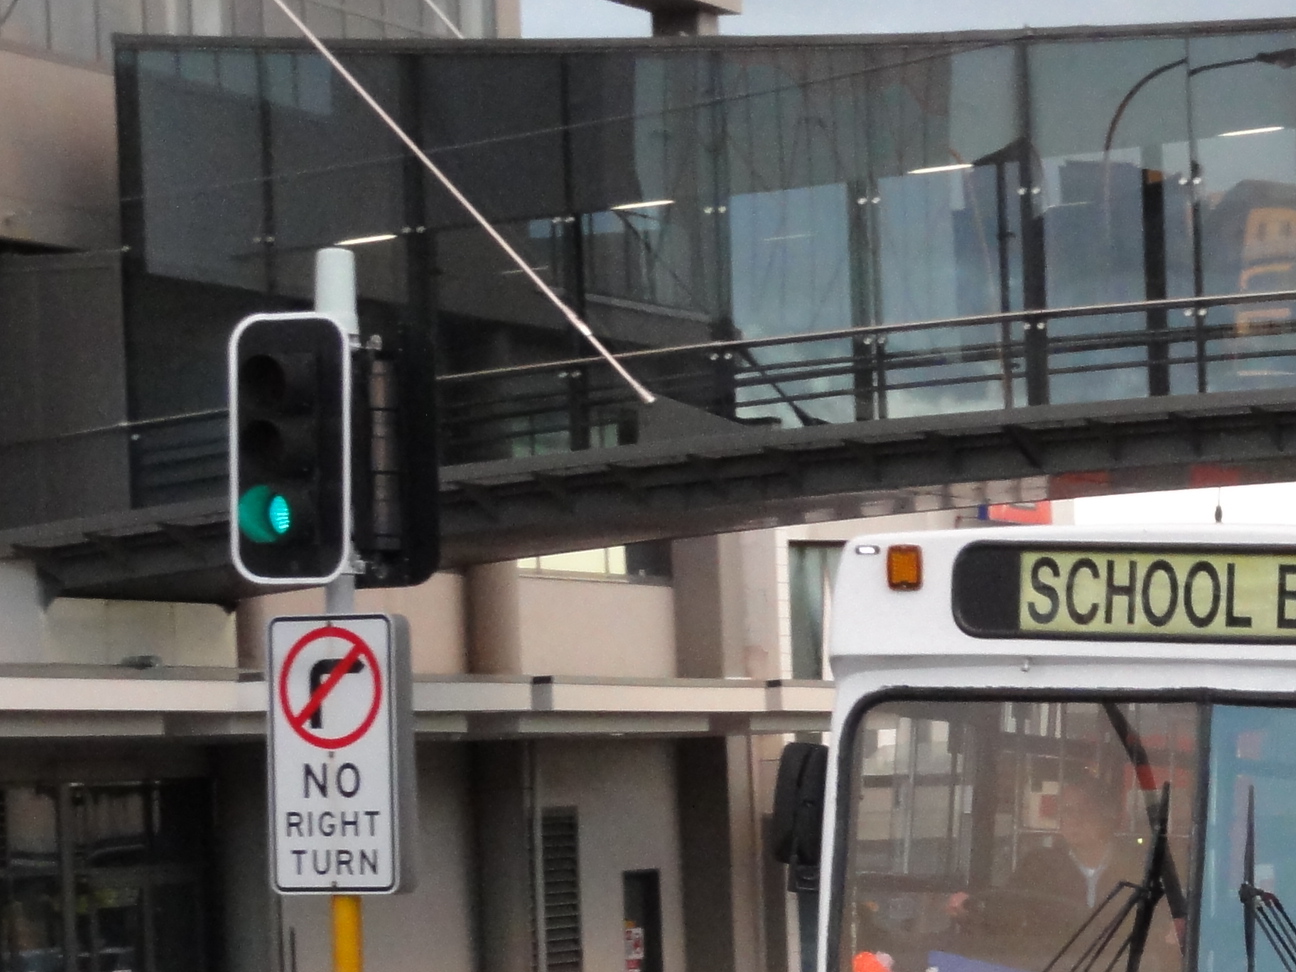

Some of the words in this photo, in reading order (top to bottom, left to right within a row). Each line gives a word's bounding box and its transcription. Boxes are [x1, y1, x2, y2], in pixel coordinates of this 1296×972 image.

[1027, 556, 1252, 629] SCHOOL
[303, 763, 361, 798] NO
[286, 811, 381, 837] RIGHT
[290, 849, 379, 875] TURN
